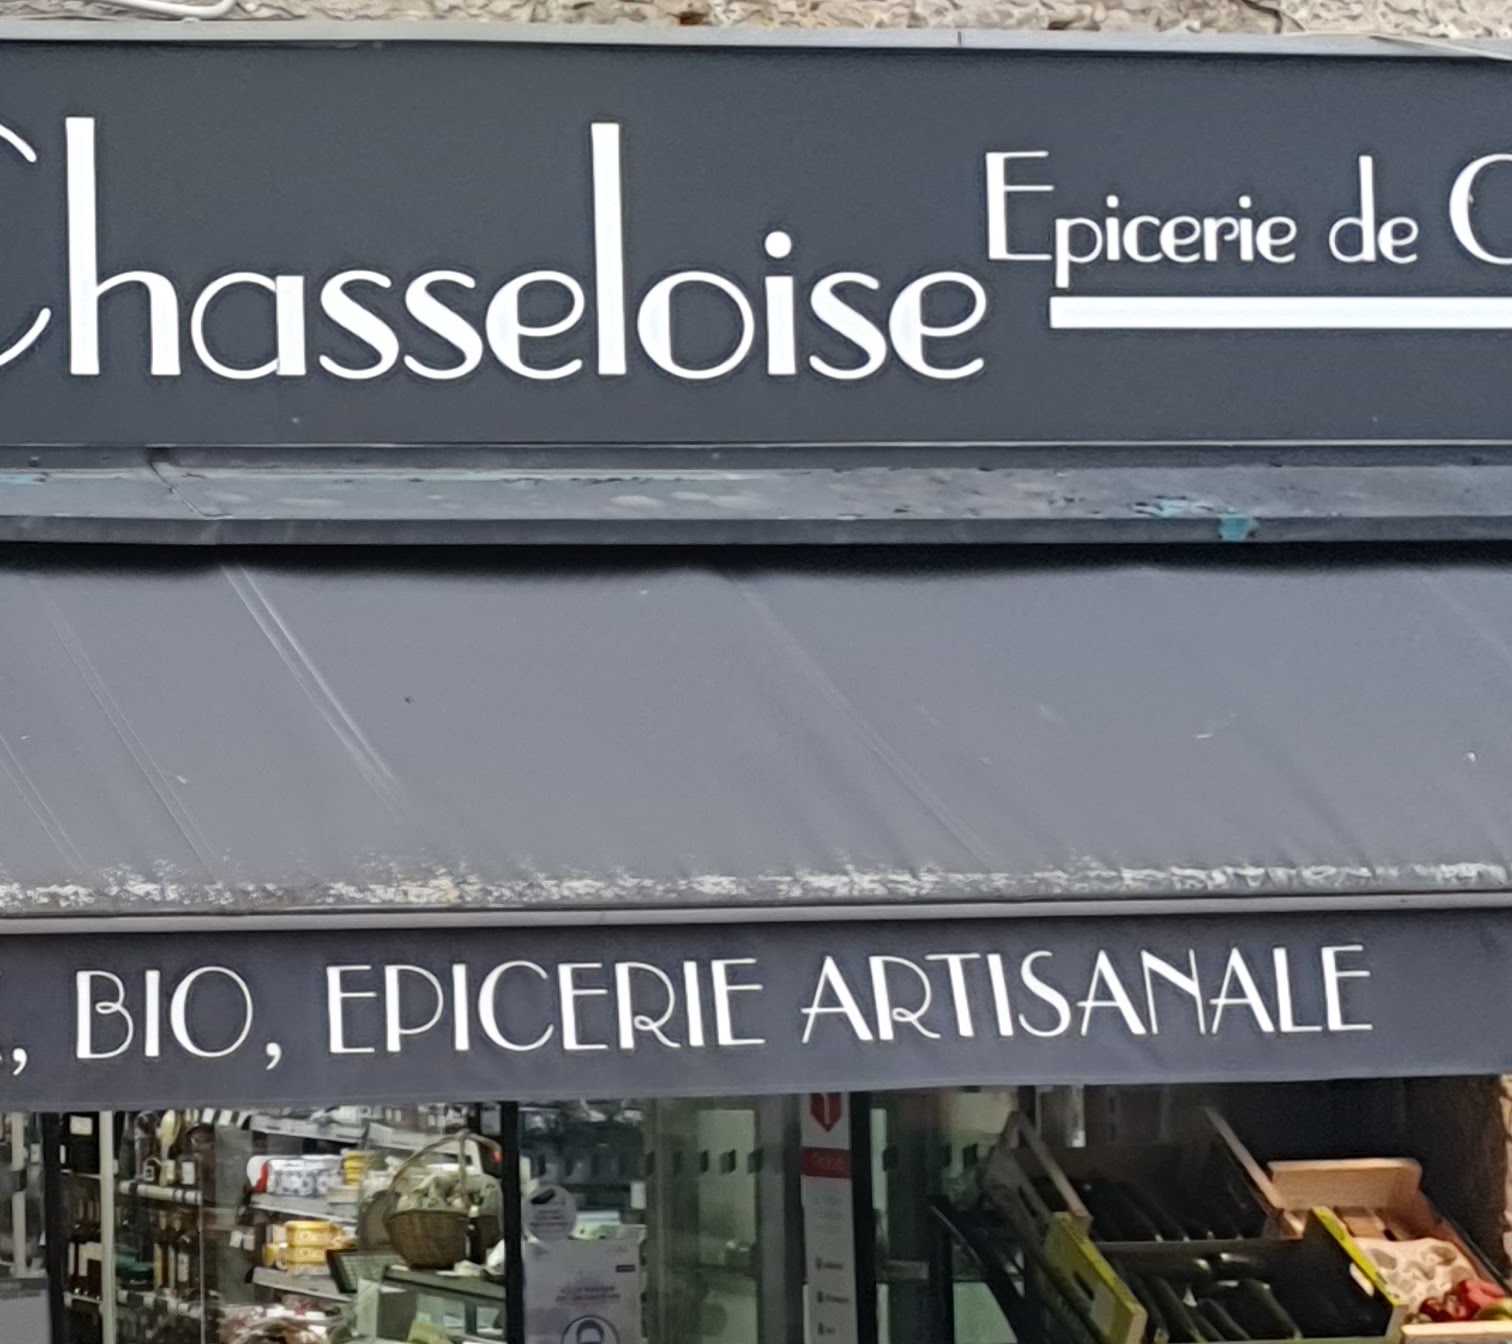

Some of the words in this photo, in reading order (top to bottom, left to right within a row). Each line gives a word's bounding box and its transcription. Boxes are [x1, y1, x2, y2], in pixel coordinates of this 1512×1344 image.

[986, 150, 1297, 288] Epicerie
[1329, 155, 1419, 264] de
[76, 966, 282, 1071] BIO,
[326, 958, 765, 1056] EPICERIE
[800, 944, 1374, 1043] ARTISANALE
